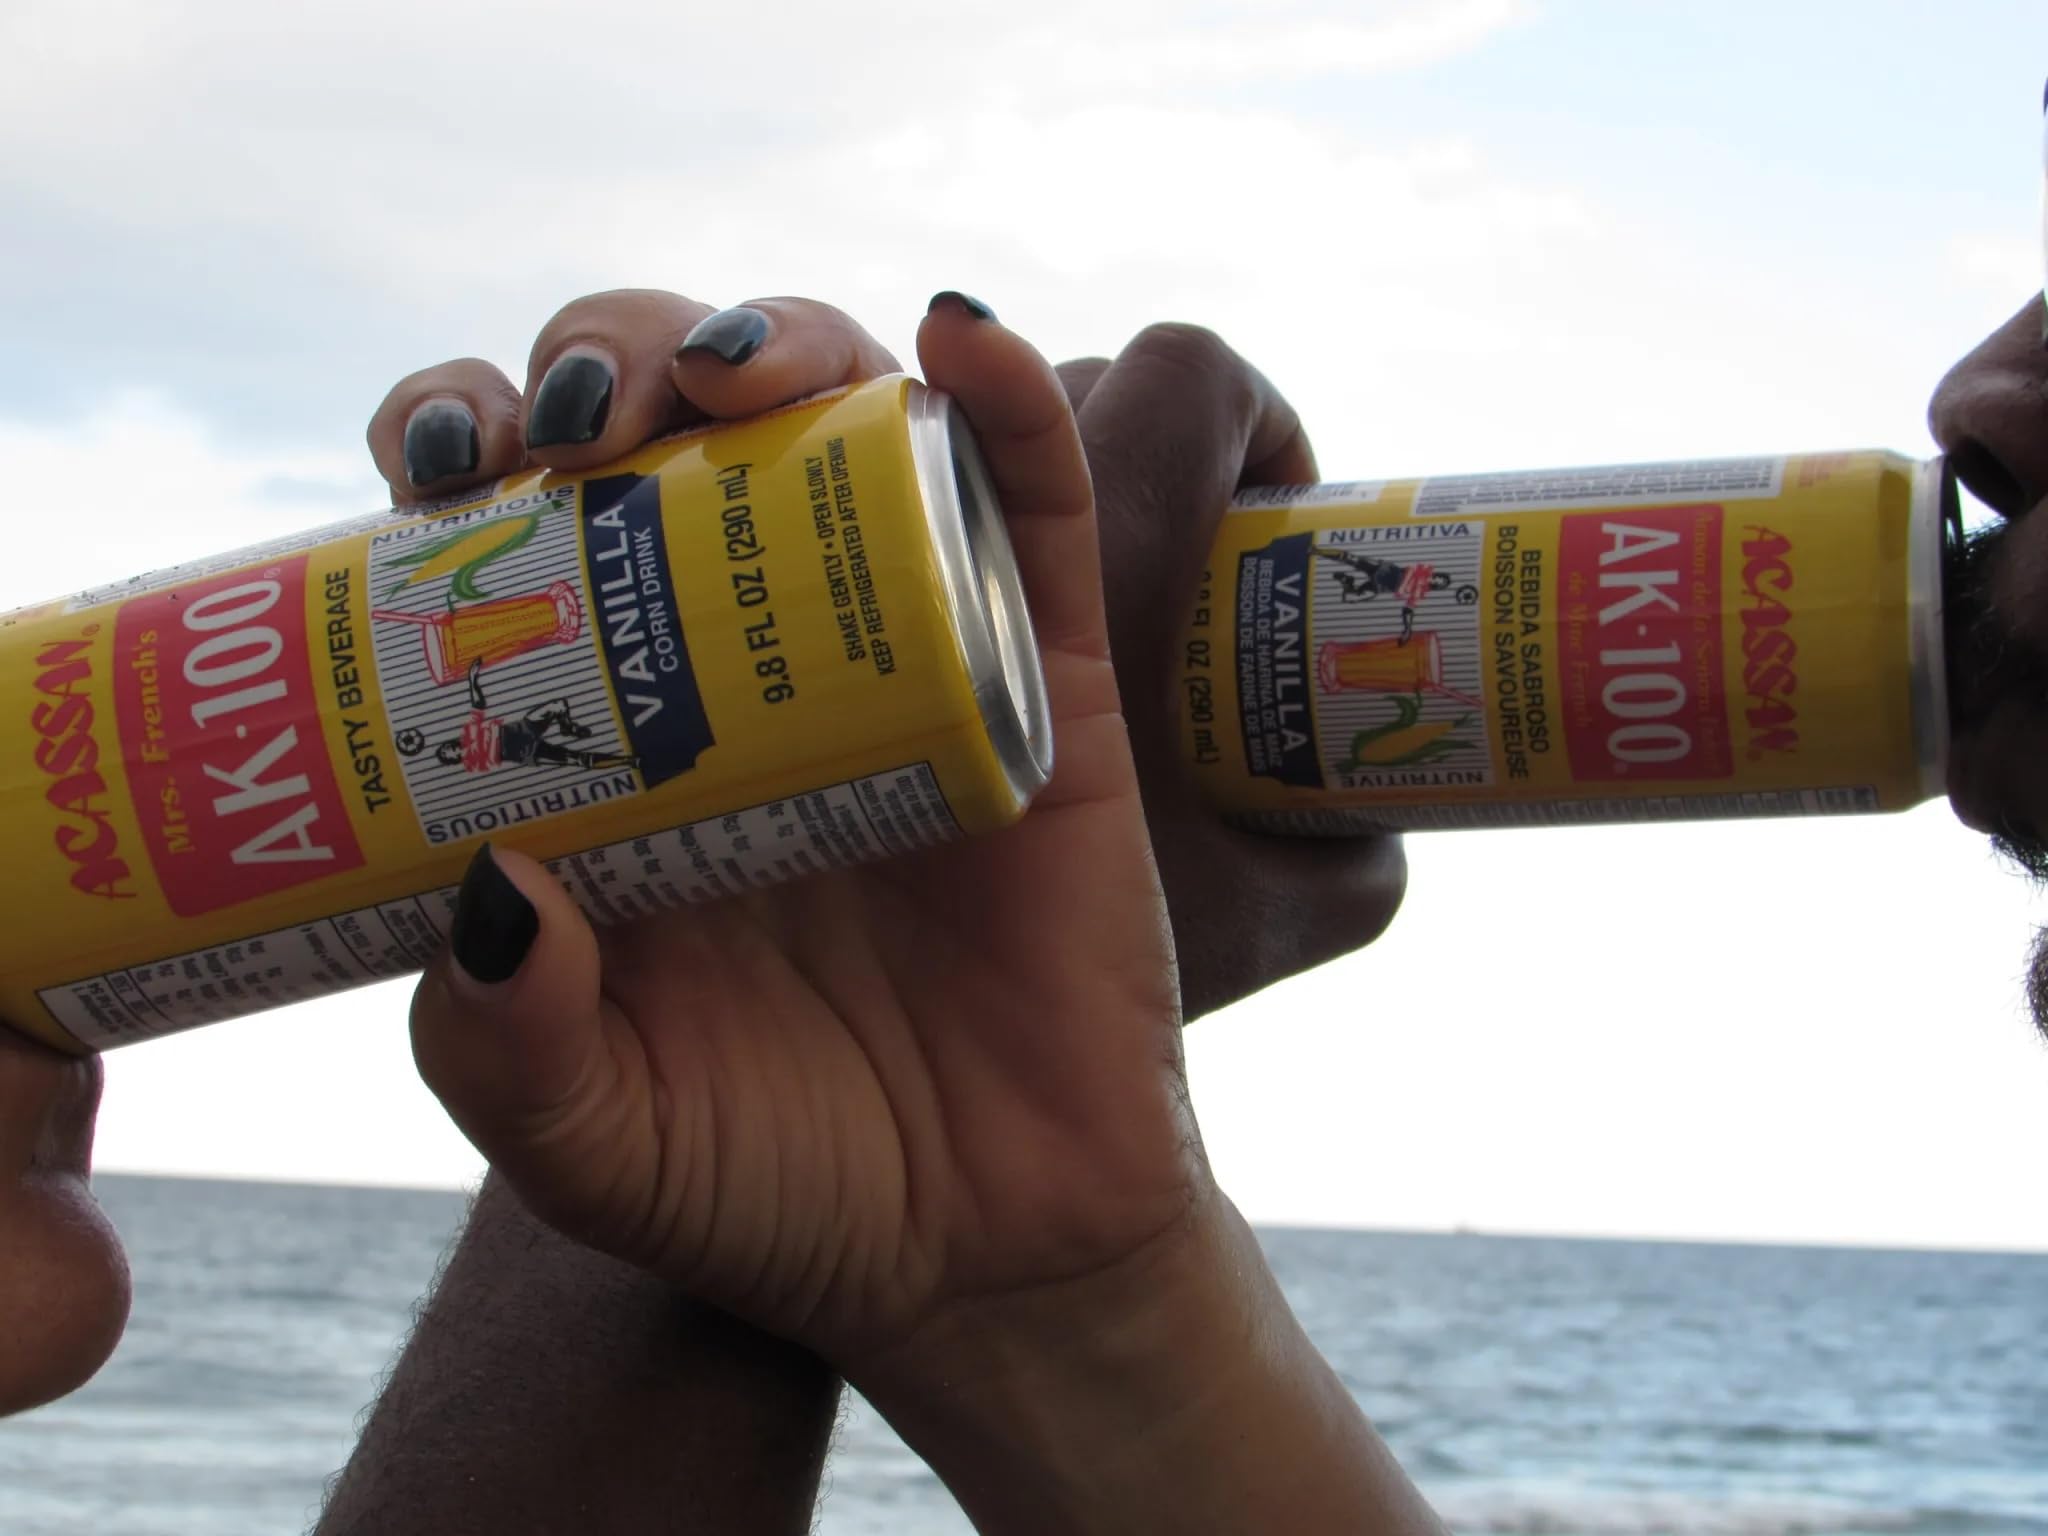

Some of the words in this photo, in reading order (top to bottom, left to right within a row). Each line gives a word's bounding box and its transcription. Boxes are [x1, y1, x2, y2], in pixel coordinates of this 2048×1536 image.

[716, 463, 753, 503] mL)
[805, 456, 827, 500] SLOWLY
[826, 437, 849, 481] OPENING
[372, 485, 575, 546] NUTRITIOUS
[813, 504, 836, 540] OPEN
[836, 480, 858, 522] AFTER
[633, 527, 663, 593] DRINK
[721, 504, 766, 561] (290
[1329, 522, 1471, 544] NUTRITIVA
[732, 567, 768, 608] OZ
[823, 554, 849, 609] GENTLY
[842, 525, 885, 635] REFRIGERATED
[1240, 556, 1257, 624] BOISSON
[1257, 558, 1274, 614] BEBIDA
[1494, 526, 1519, 625] BOISSON
[1520, 549, 1541, 636] BEBIDA
[326, 568, 362, 708] BEVERAGE
[593, 504, 664, 727] VANILLA
[648, 600, 679, 673] CORN
[744, 611, 780, 651] FL
[837, 614, 866, 662] SHAKE
[1239, 627, 1256, 649] DE
[1256, 617, 1273, 640] DE
[1741, 524, 1799, 753] ACASSAN
[756, 655, 794, 704] 9.8
[872, 639, 896, 676] KEEP
[1186, 640, 1211, 669] OZ
[1240, 653, 1260, 712] FARINE
[1257, 643, 1275, 708] HARINA
[1273, 573, 1307, 752] VANILLA
[130, 629, 170, 764] French's
[1184, 676, 1214, 724] (290
[1245, 714, 1263, 736] DE
[1260, 708, 1278, 730] DE
[1495, 631, 1529, 779] SAVOUREUSE
[1520, 642, 1549, 753] SABROSO
[32, 641, 138, 899] ACASSAN
[347, 718, 392, 814] TASTY
[161, 776, 195, 854] Mrs.
[427, 773, 637, 844] NUTRITIOUS
